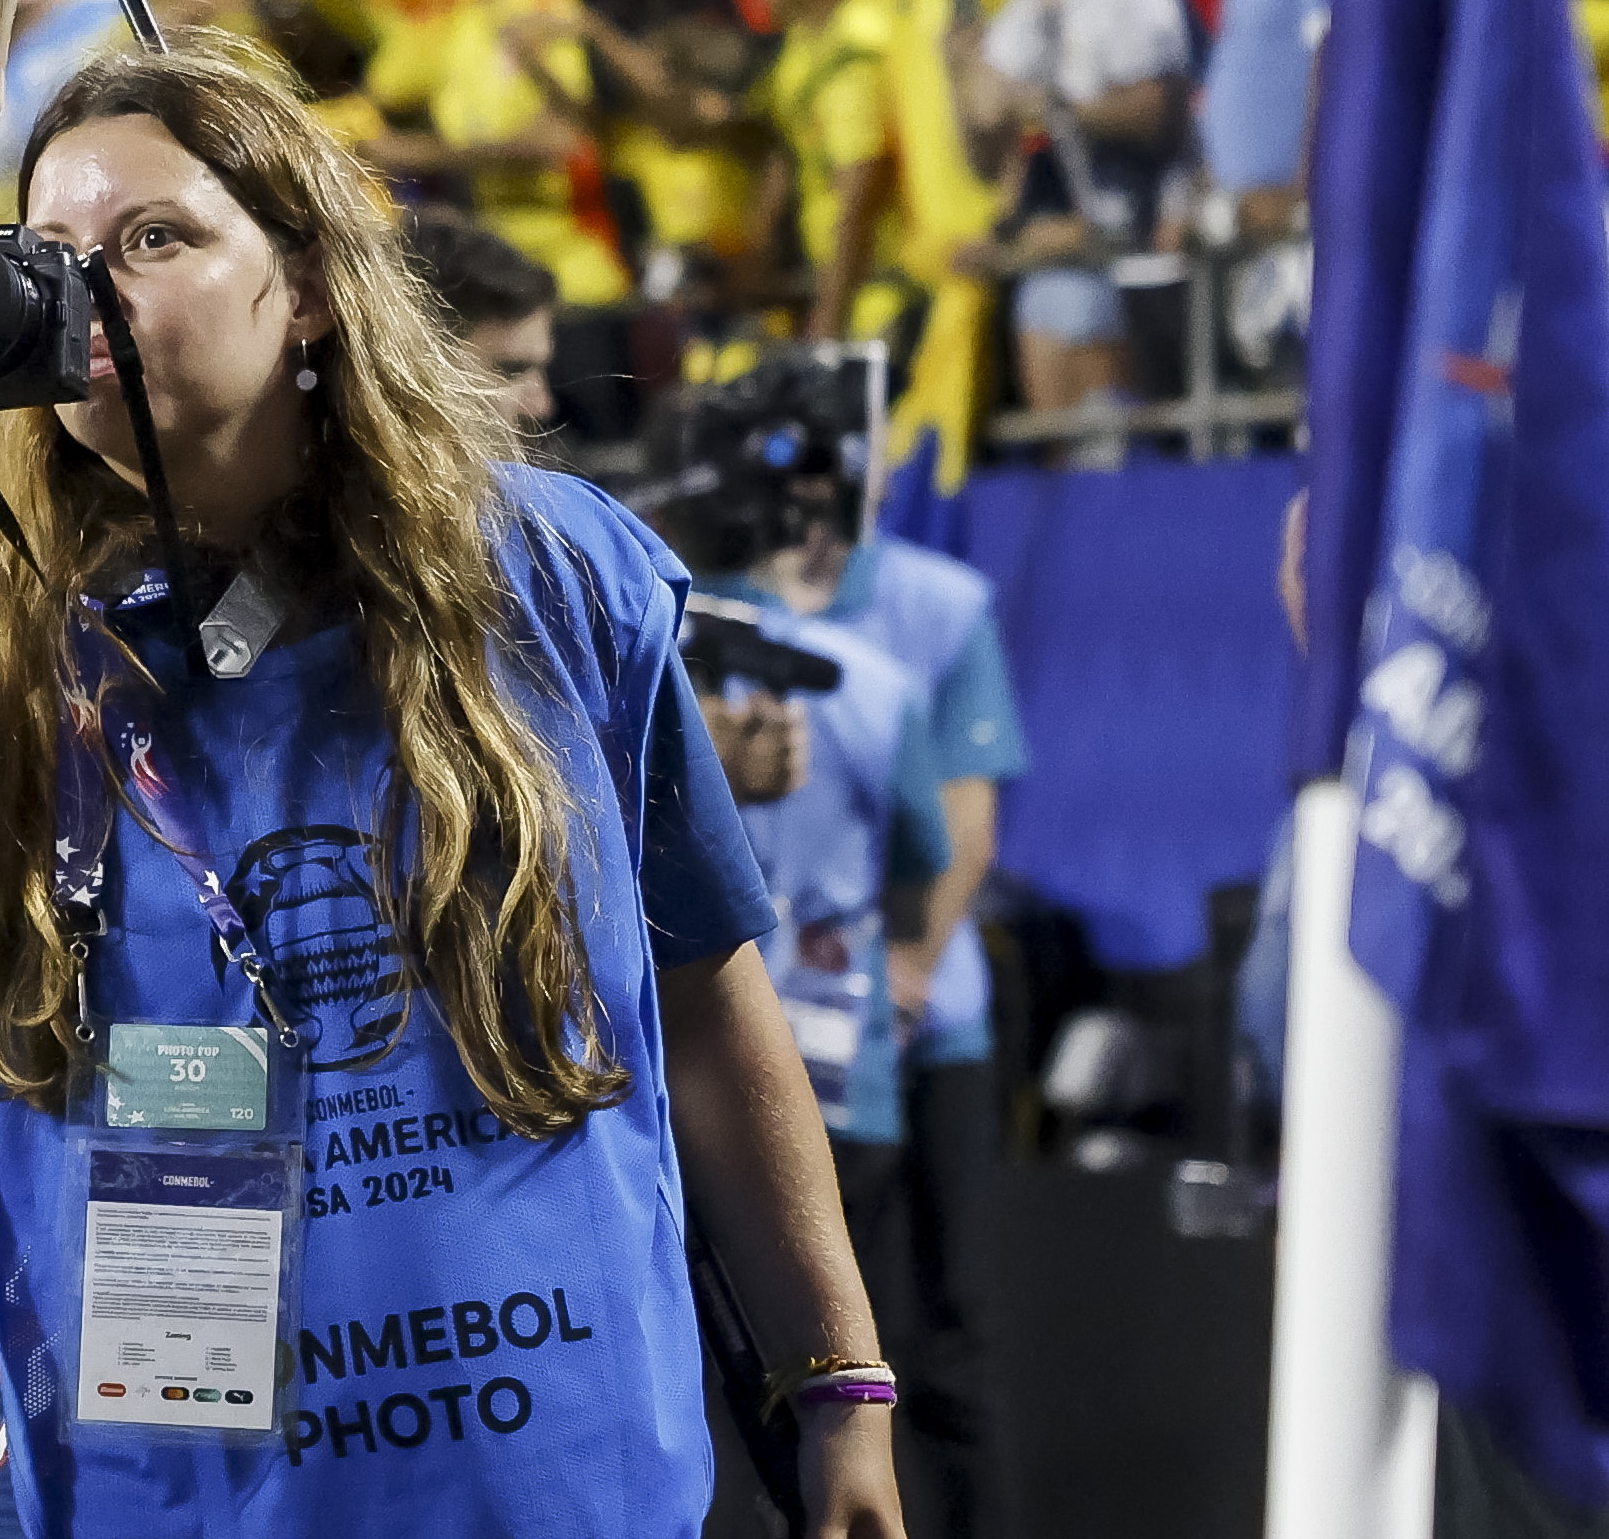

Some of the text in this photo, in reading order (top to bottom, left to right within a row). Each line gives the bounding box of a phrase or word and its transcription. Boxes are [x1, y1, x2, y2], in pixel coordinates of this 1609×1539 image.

[157, 1044, 194, 1057] PHOTO
[168, 1058, 207, 1083] 30
[229, 1107, 254, 1120] 120
[162, 1174, 211, 1189] CONMEBOL
[305, 1165, 456, 1218] SA 2024
[284, 1376, 533, 1468] PHOTO
